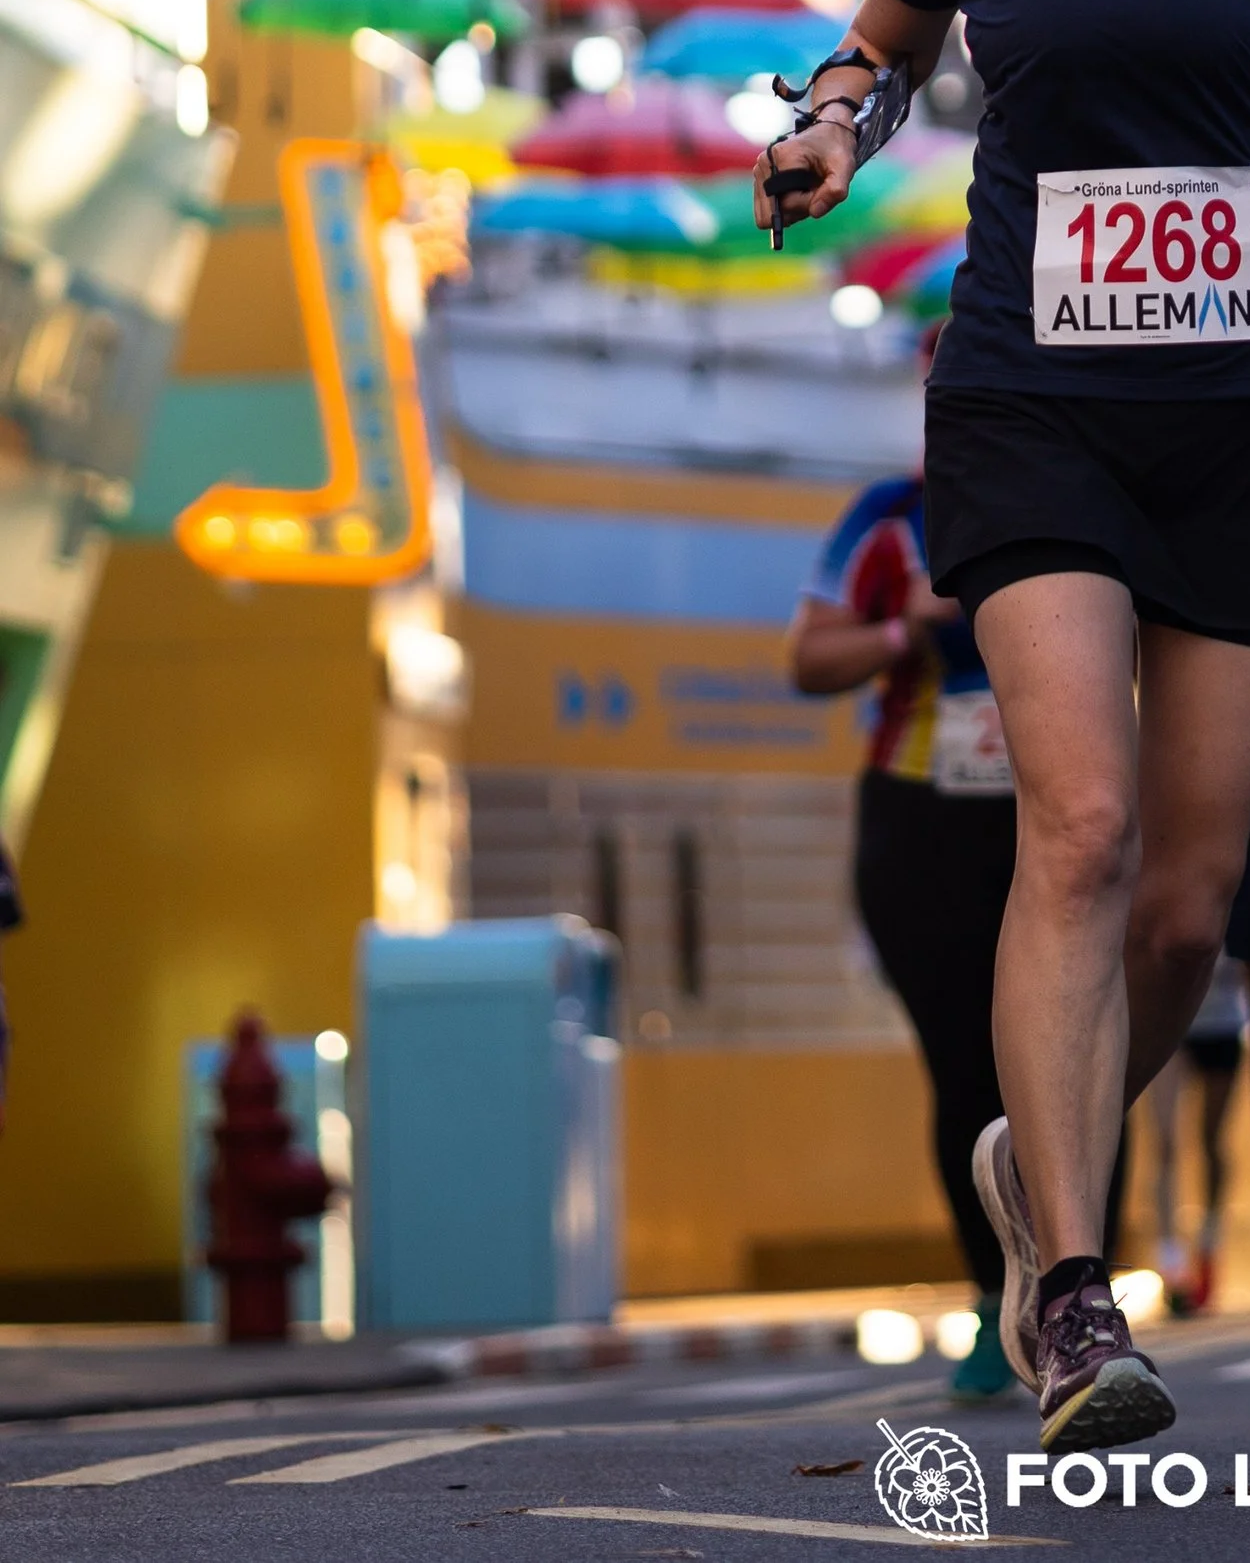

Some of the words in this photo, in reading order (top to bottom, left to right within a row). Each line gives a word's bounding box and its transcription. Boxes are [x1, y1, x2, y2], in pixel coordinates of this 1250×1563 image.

[1082, 182, 1122, 198] Gröna
[1126, 180, 1219, 197] Lund-sprinten
[1067, 198, 1241, 283] 1268
